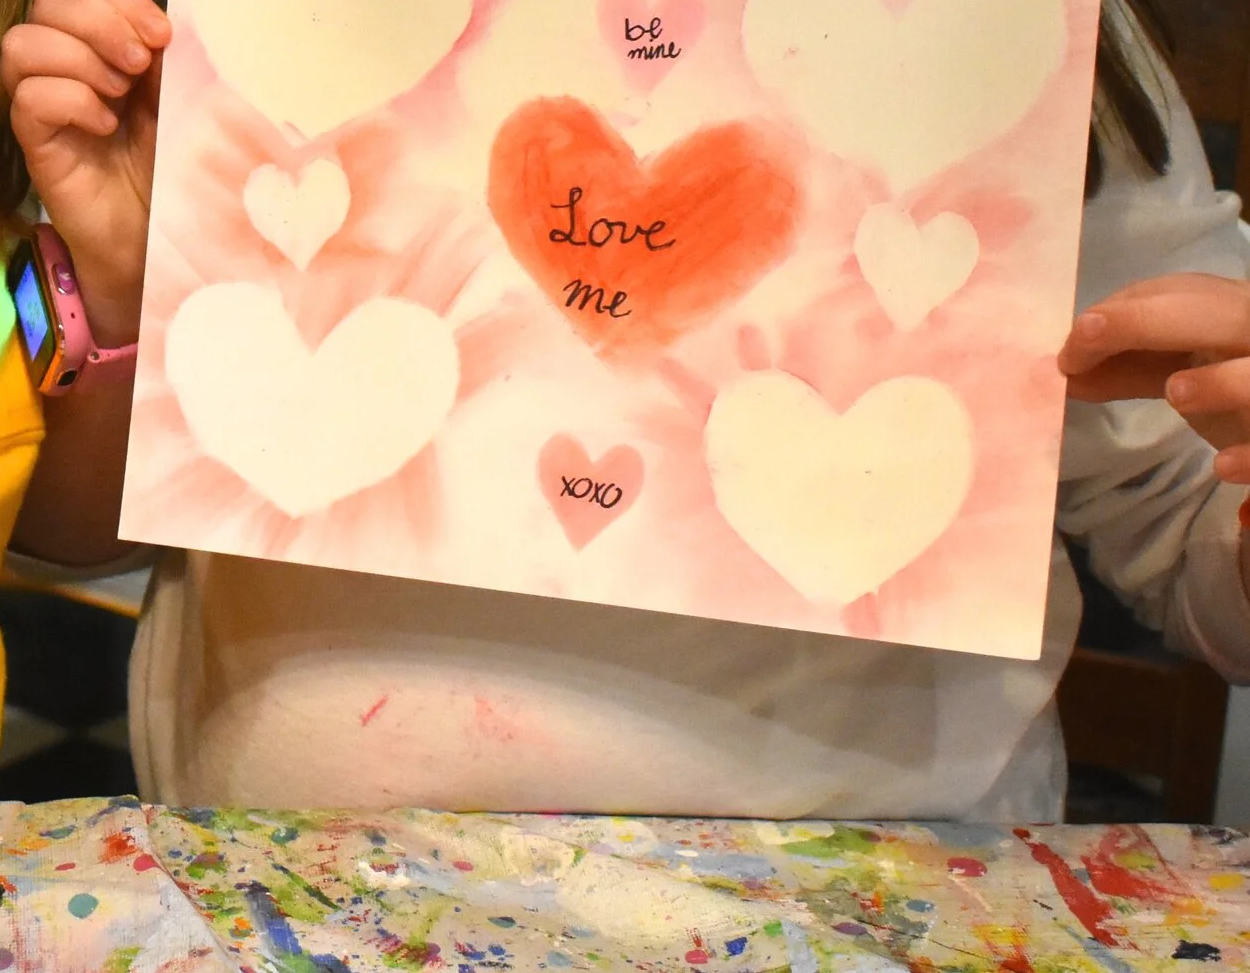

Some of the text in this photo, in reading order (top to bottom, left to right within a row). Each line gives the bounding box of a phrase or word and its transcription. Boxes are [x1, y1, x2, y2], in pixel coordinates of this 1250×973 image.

[624, 16, 663, 41] be
[627, 38, 682, 60] mine
[549, 186, 677, 252] Love
